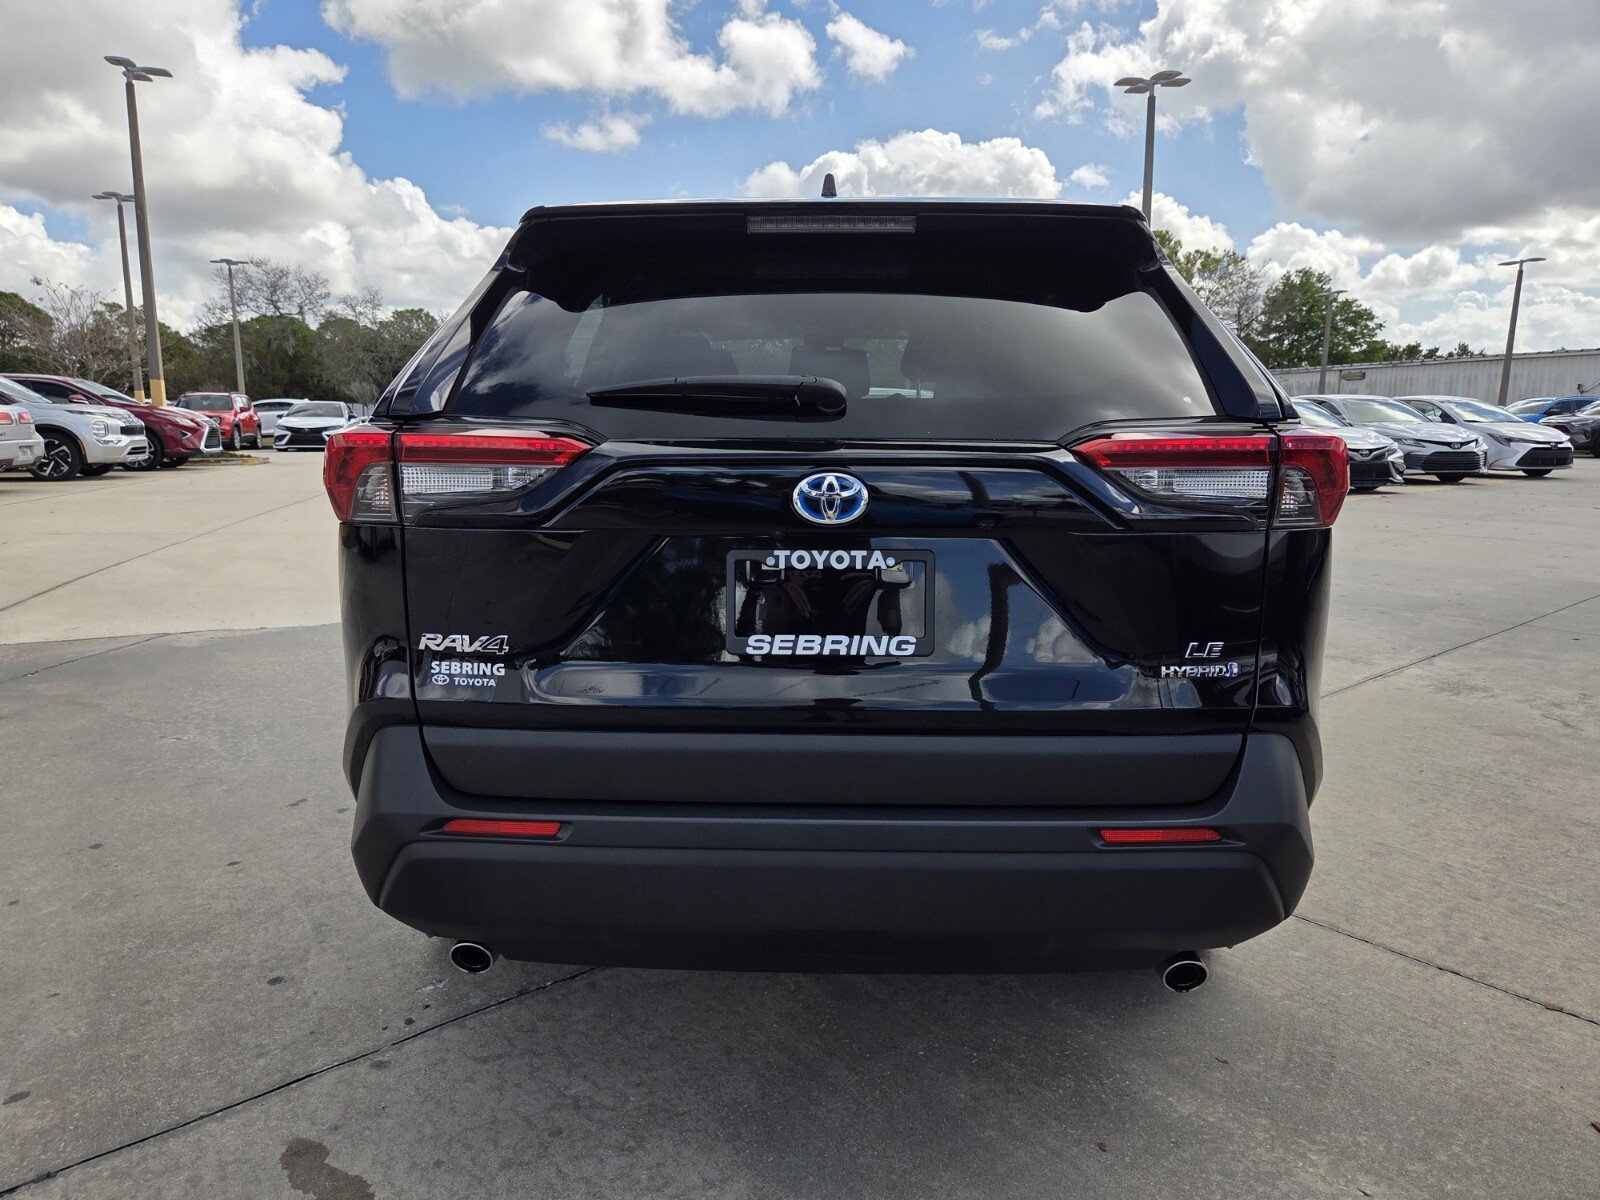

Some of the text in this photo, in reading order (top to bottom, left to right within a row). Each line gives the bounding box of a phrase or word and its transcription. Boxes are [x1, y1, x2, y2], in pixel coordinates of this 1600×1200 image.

[773, 549, 888, 570] TOYOTA
[418, 633, 509, 655] RAV4
[745, 634, 917, 656] SEBRING
[1185, 642, 1224, 658] LE
[430, 661, 506, 676] SEBRING
[1161, 665, 1226, 678] HYBRID
[453, 677, 497, 687] TOYOTA
